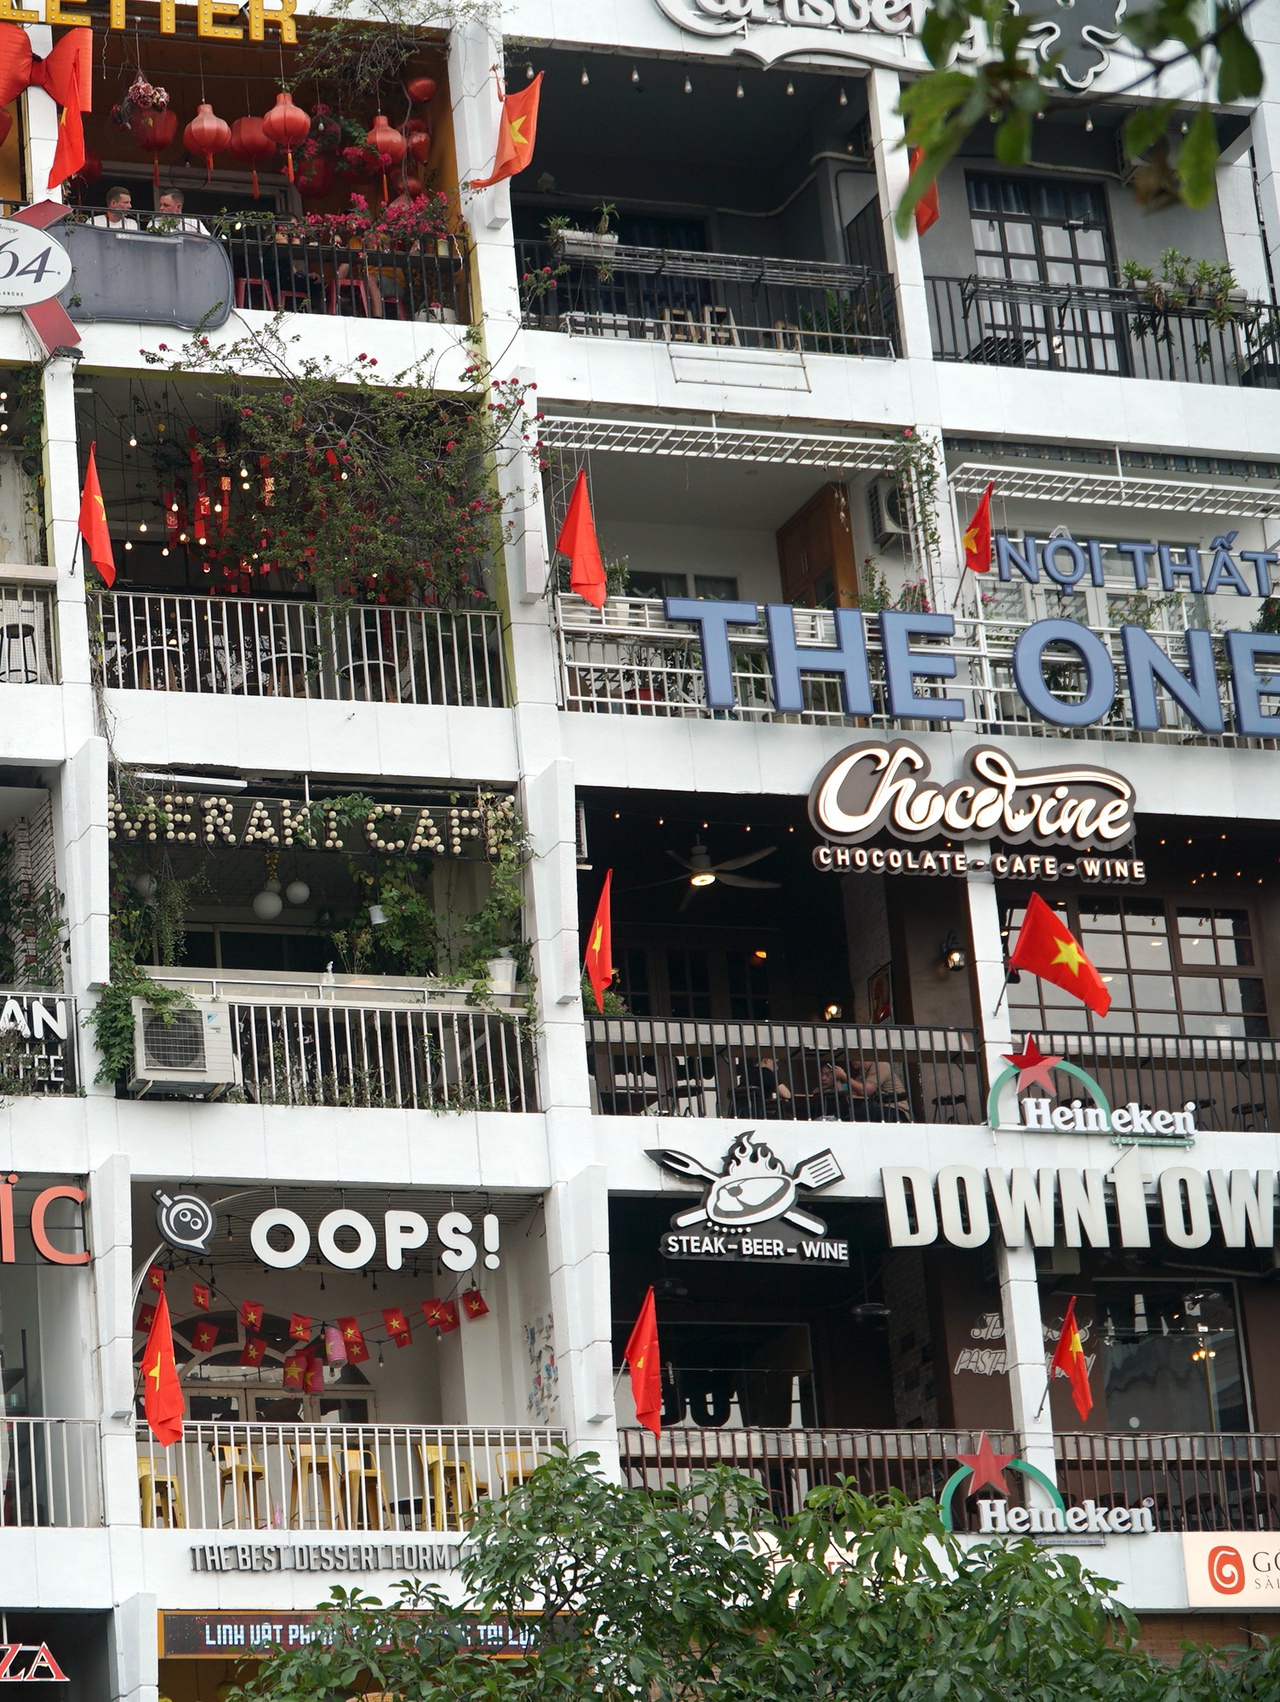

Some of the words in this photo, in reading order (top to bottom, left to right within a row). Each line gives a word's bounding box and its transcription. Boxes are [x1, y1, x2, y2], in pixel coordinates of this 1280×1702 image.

[994, 524, 1106, 597] NỘI
[1117, 530, 1278, 597] THẤT
[663, 597, 966, 722] THE
[1011, 617, 1280, 737] ONE
[819, 847, 968, 872] CHOCOLATE
[996, 855, 1058, 877] CAFE
[1082, 859, 1146, 880] WINE
[1021, 1097, 1198, 1136] Heineken
[250, 1207, 501, 1272] OOPS!
[667, 1235, 727, 1255] STEAK
[742, 1238, 785, 1257] BEER
[801, 1240, 849, 1261] WINE
[976, 1497, 1157, 1534] Heineken
[190, 1544, 232, 1571] THE
[236, 1544, 286, 1571] BEST
[295, 1544, 384, 1571] DESSERT
